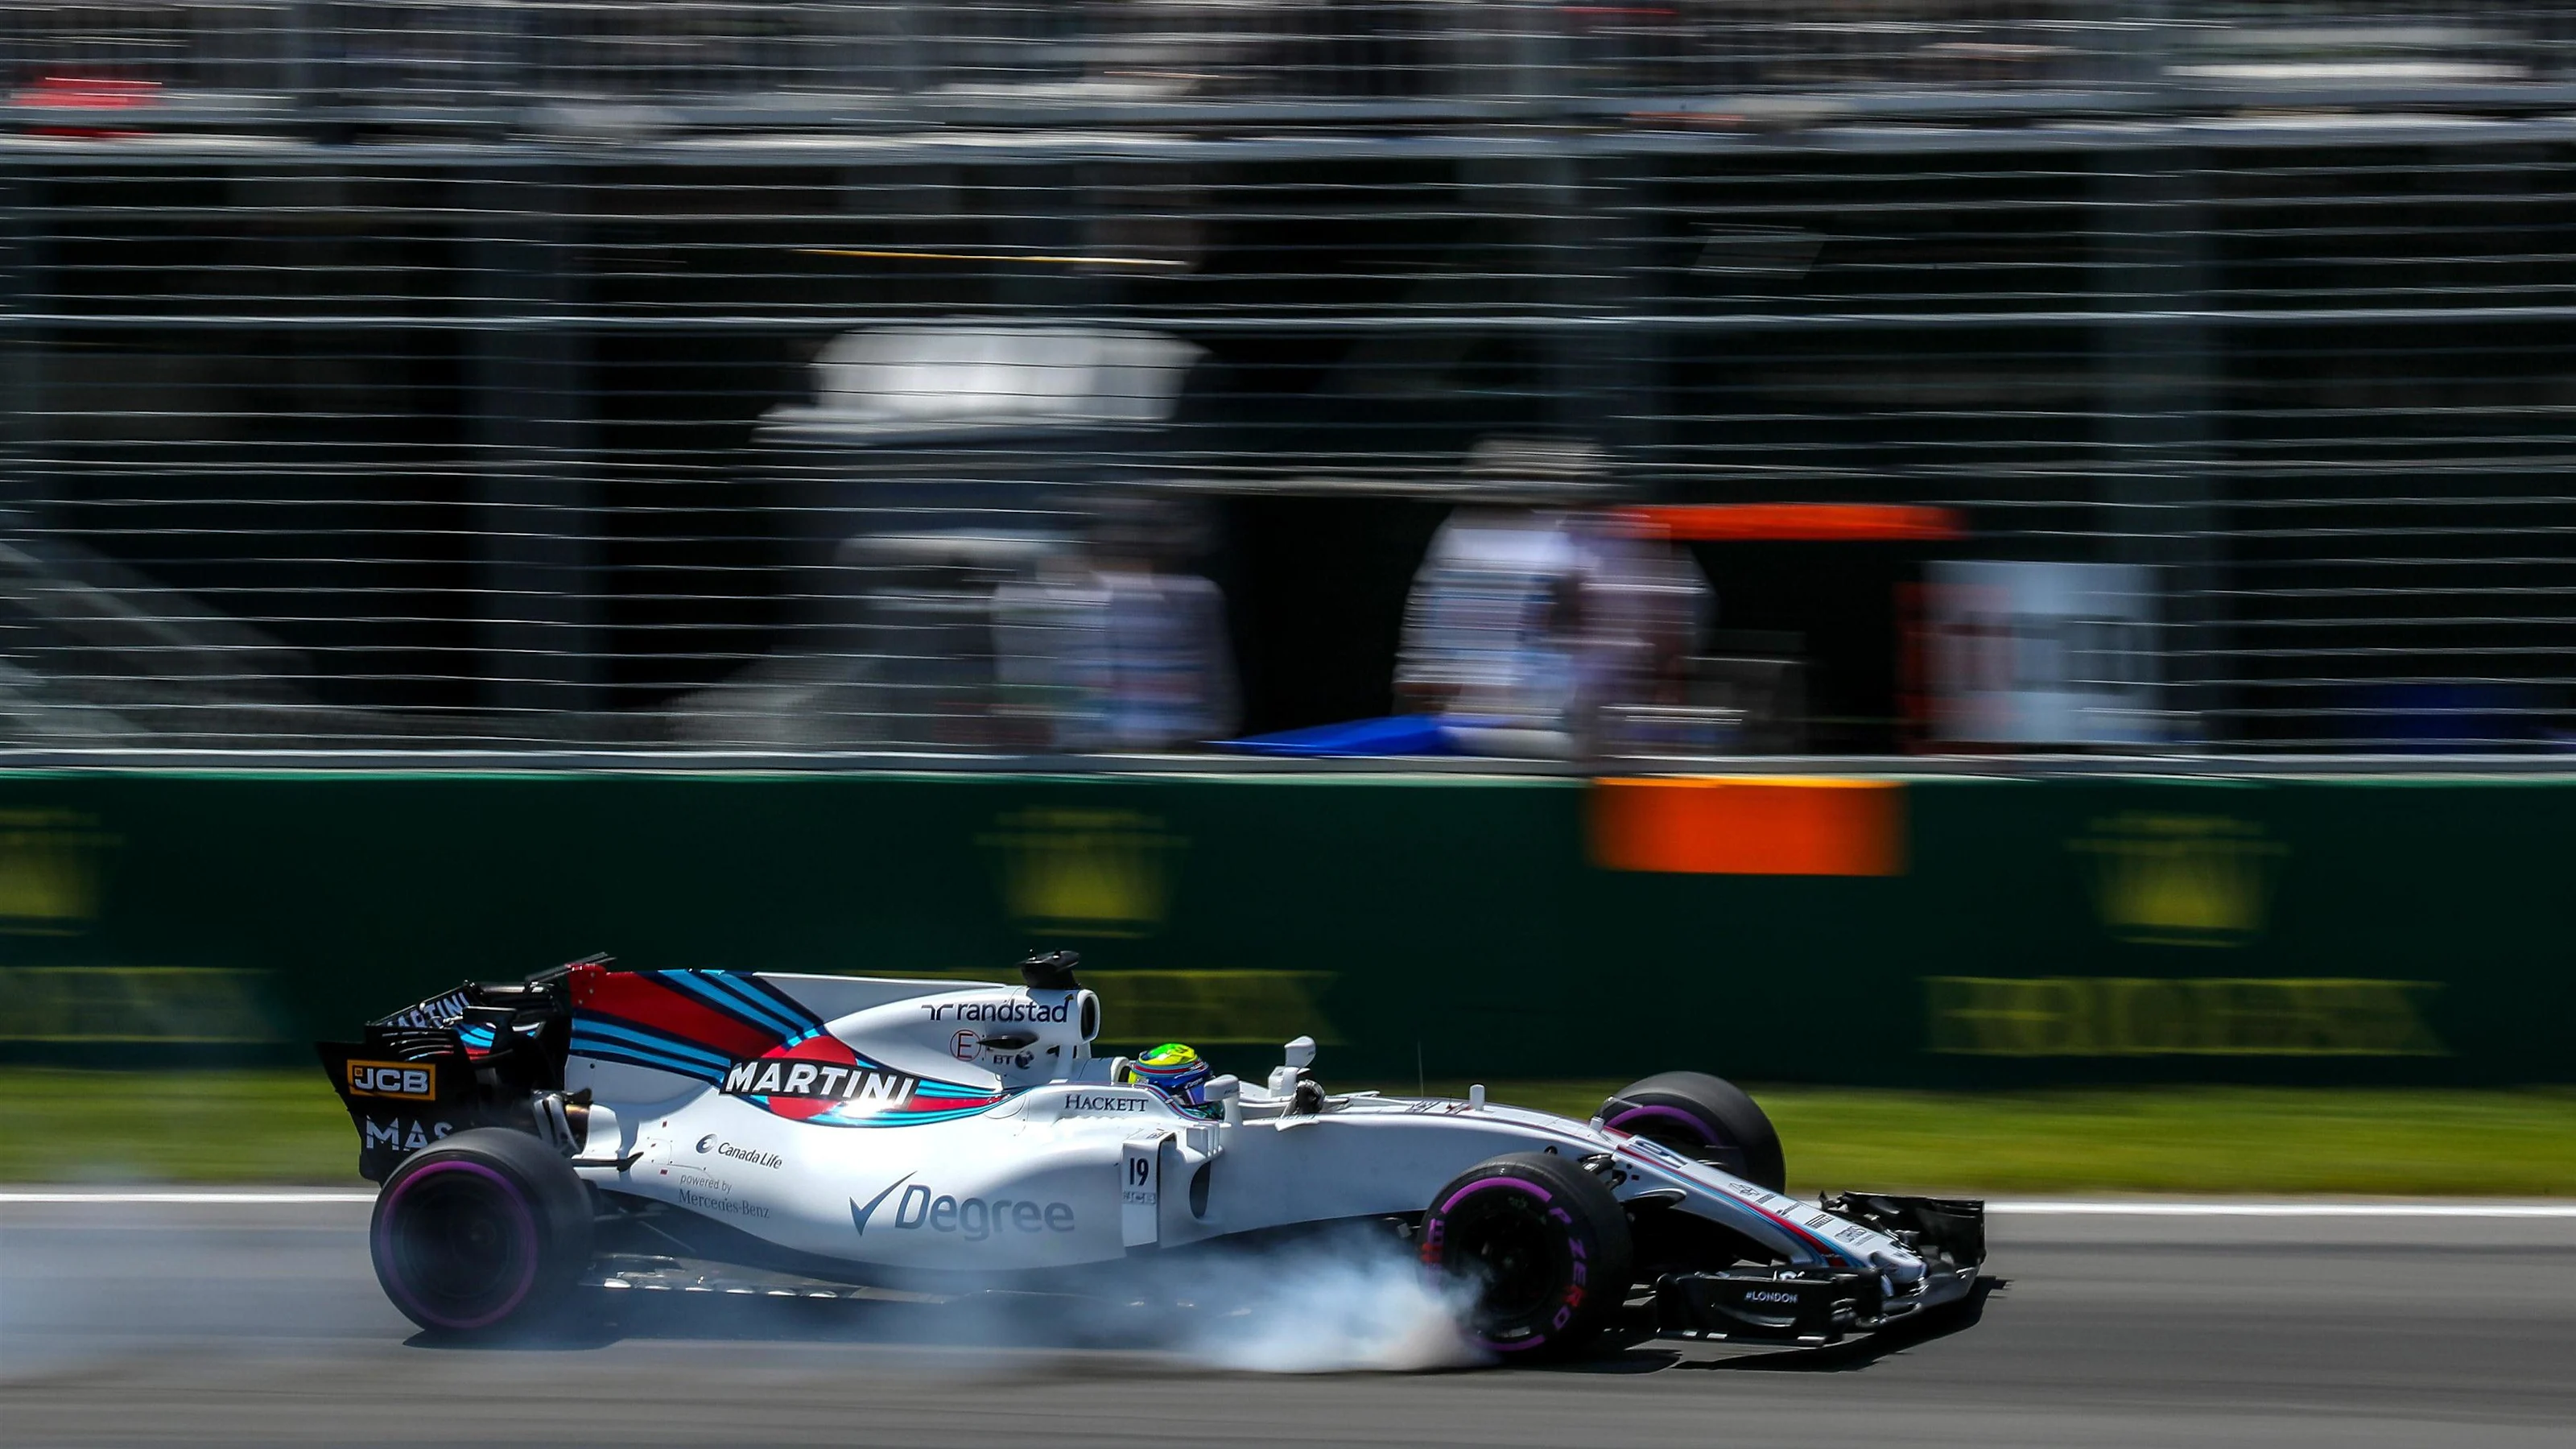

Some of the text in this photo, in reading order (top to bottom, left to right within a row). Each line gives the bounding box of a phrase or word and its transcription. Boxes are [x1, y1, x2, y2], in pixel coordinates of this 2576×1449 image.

[957, 995, 1070, 1023] randstad
[957, 1033, 974, 1059] E
[993, 1055, 1013, 1065] BT
[354, 1068, 428, 1094] JCB
[725, 1061, 914, 1107] MARTINI
[718, 1142, 783, 1170] Canada Life
[679, 1174, 733, 1195] powered by
[1129, 1158, 1150, 1187] 19
[679, 1189, 770, 1219] Mercedes-Benz
[894, 1184, 1075, 1242] Degree
[1553, 1236, 1587, 1330] ZERO
[1745, 1290, 1798, 1303] #LONDON
